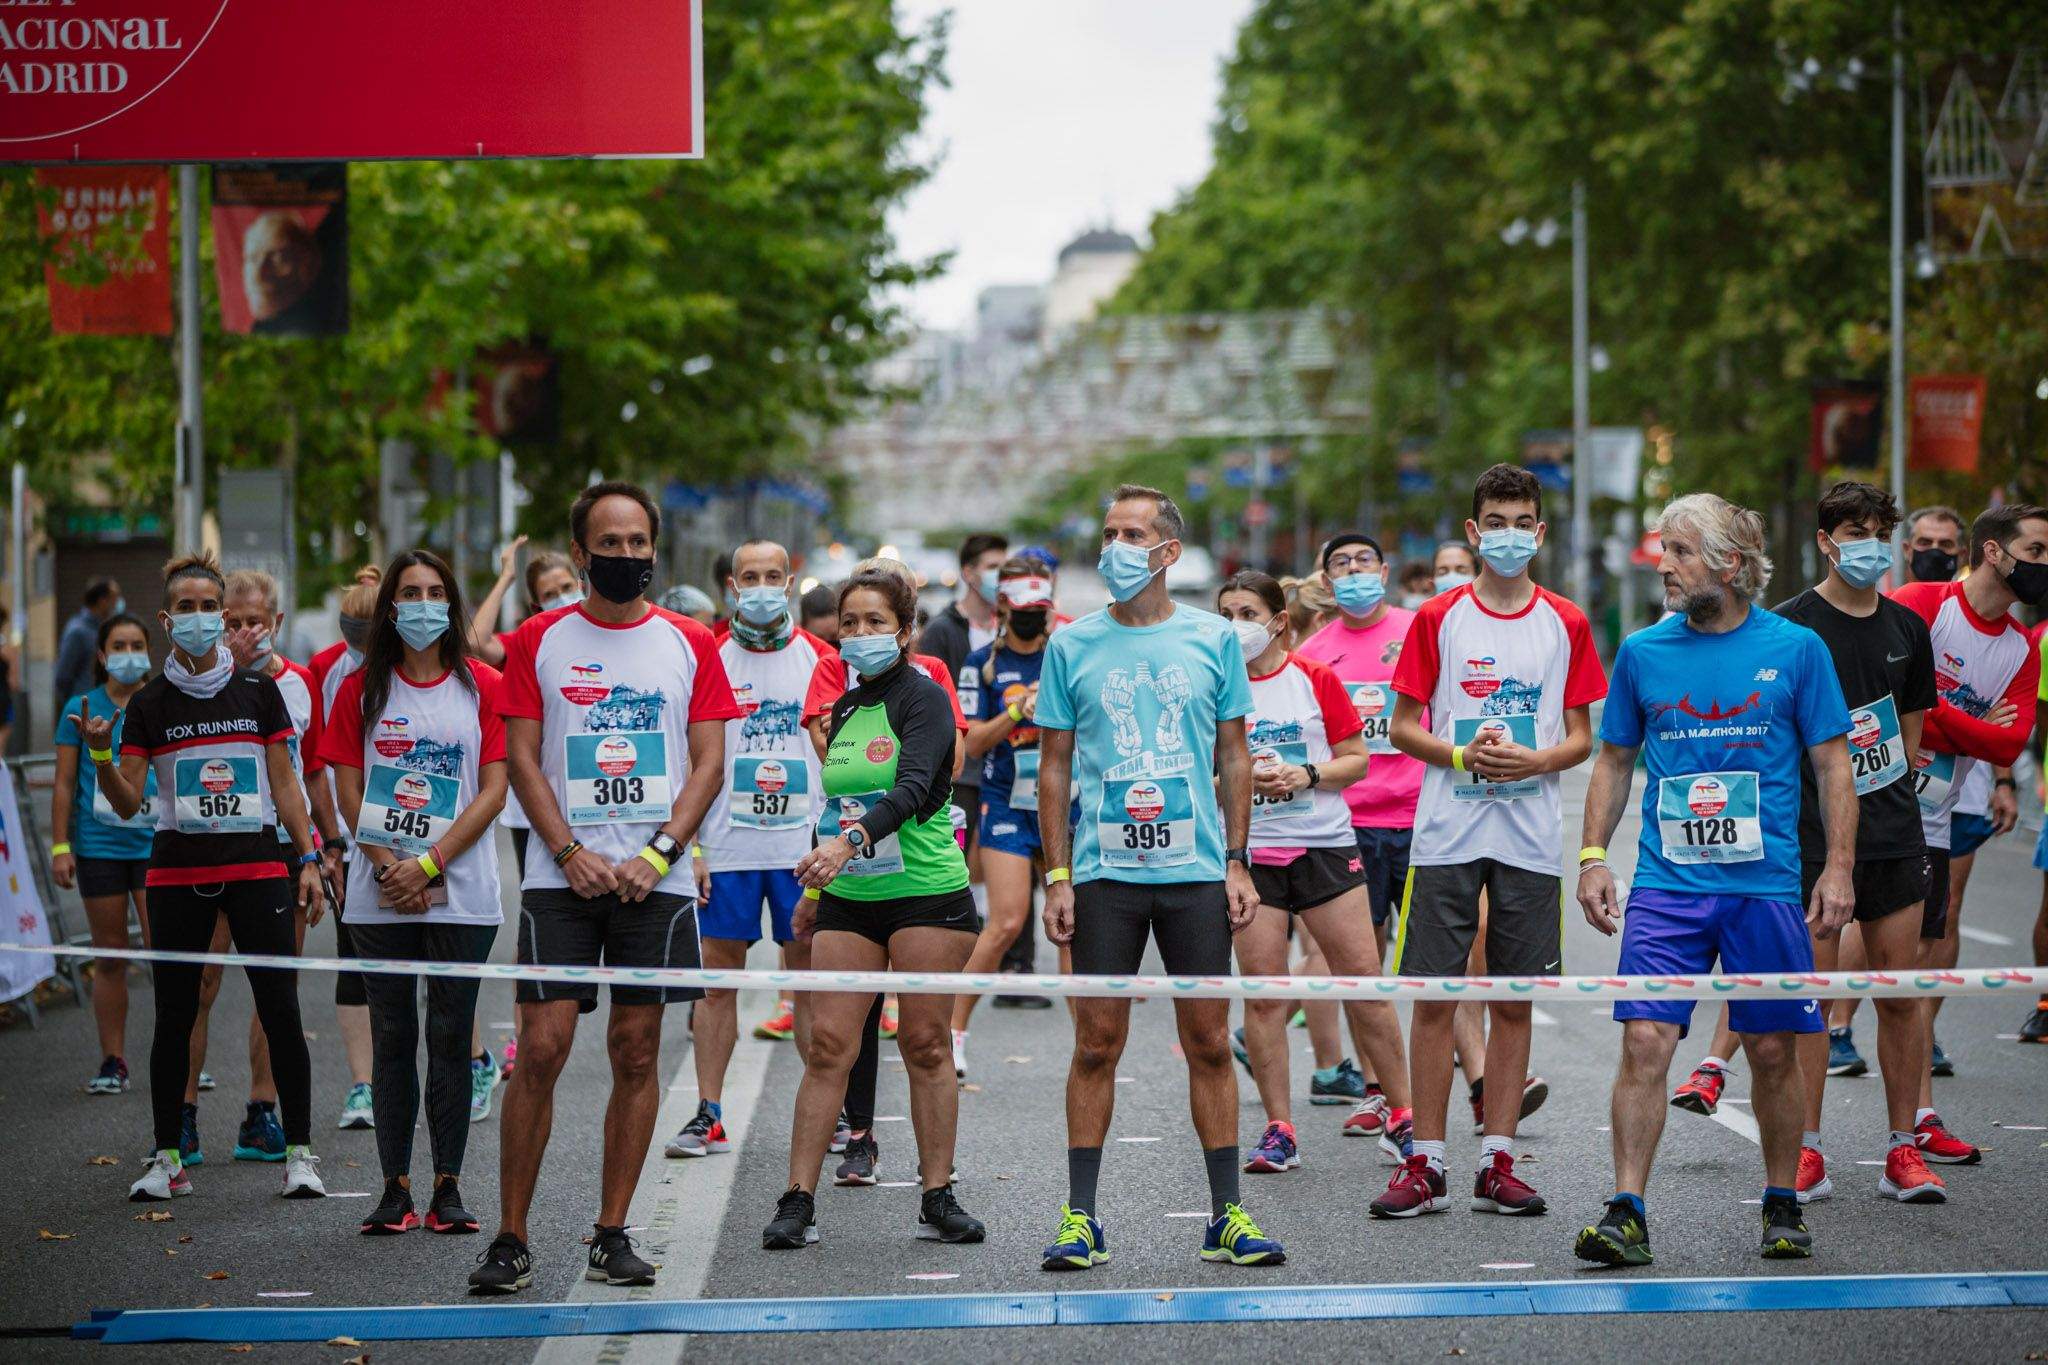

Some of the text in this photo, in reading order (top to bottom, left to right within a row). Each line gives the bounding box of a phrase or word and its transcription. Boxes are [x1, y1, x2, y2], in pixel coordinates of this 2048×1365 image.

[63, 181, 157, 208] ERNÁN
[166, 719, 259, 742] FOX RUNNERS
[1688, 726, 1743, 738] MARATHON
[1746, 726, 1768, 736] 2017
[1851, 742, 1891, 778] 260
[594, 777, 644, 805] 303
[753, 794, 789, 815] 537
[200, 794, 242, 818] 562
[384, 808, 431, 839] 545
[1123, 822, 1171, 850] 395
[1681, 818, 1738, 846] 1128
